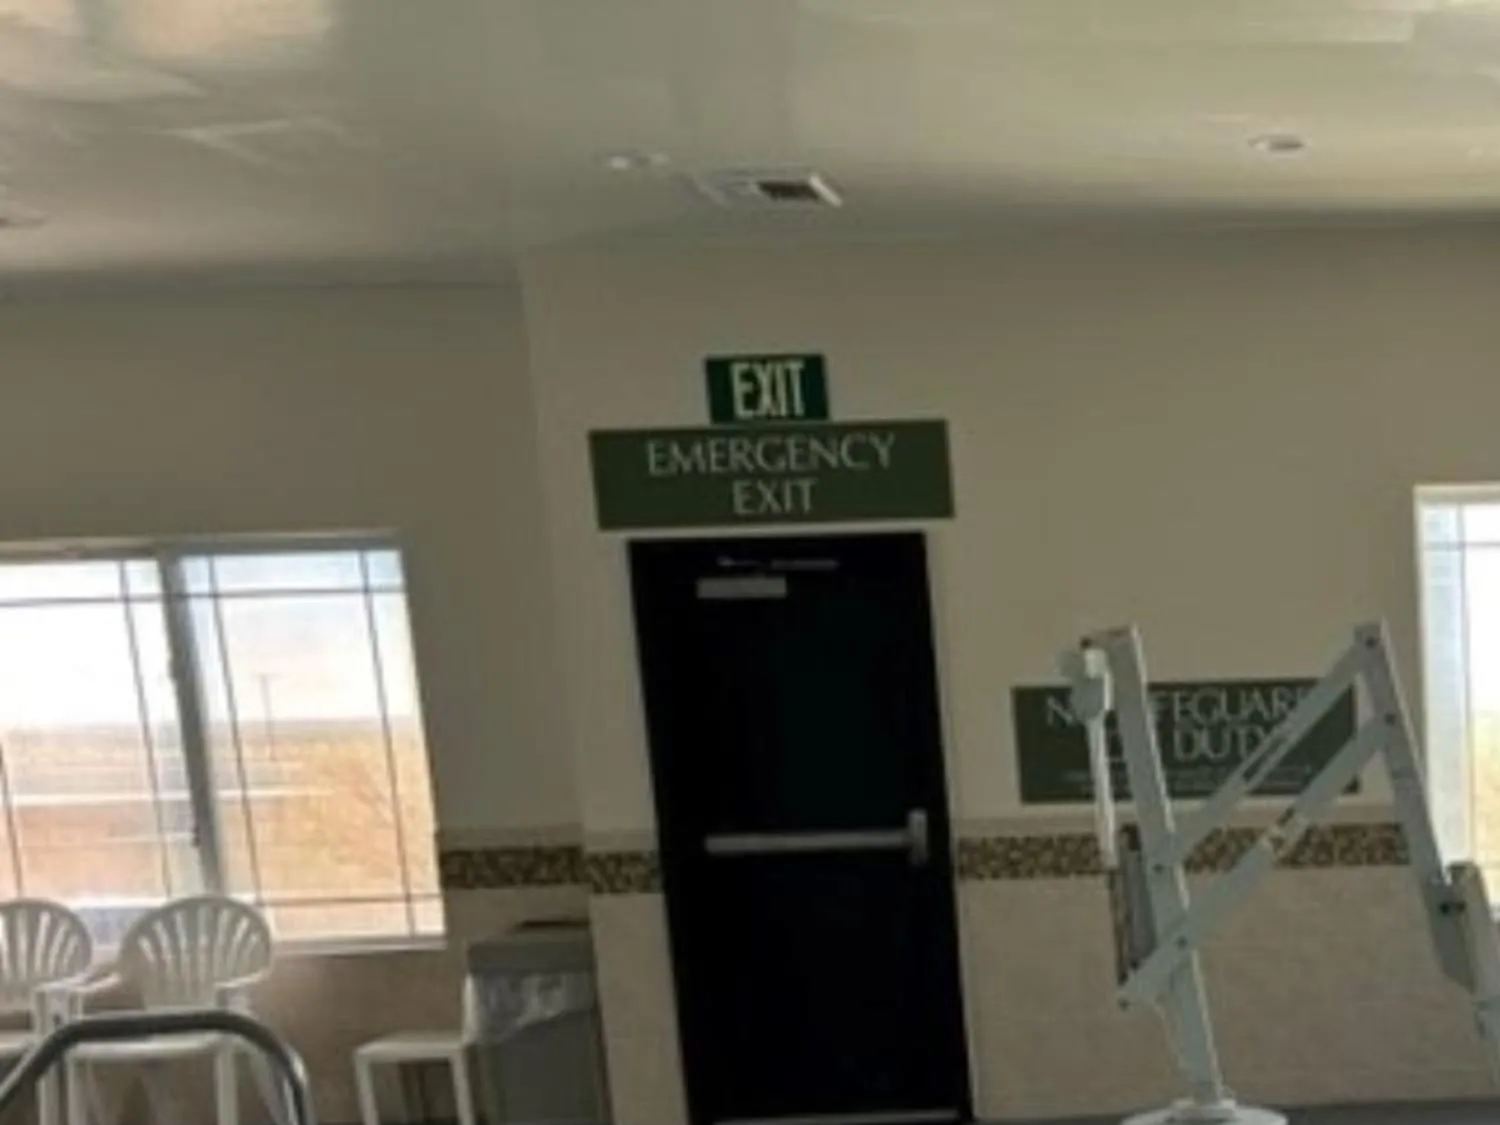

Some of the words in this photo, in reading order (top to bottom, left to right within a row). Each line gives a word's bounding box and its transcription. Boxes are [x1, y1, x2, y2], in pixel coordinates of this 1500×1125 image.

[730, 361, 804, 417] EXIT
[648, 433, 894, 474] EMERGENCY
[733, 478, 817, 515] EXIT
[1148, 687, 1321, 725] FEGUAR
